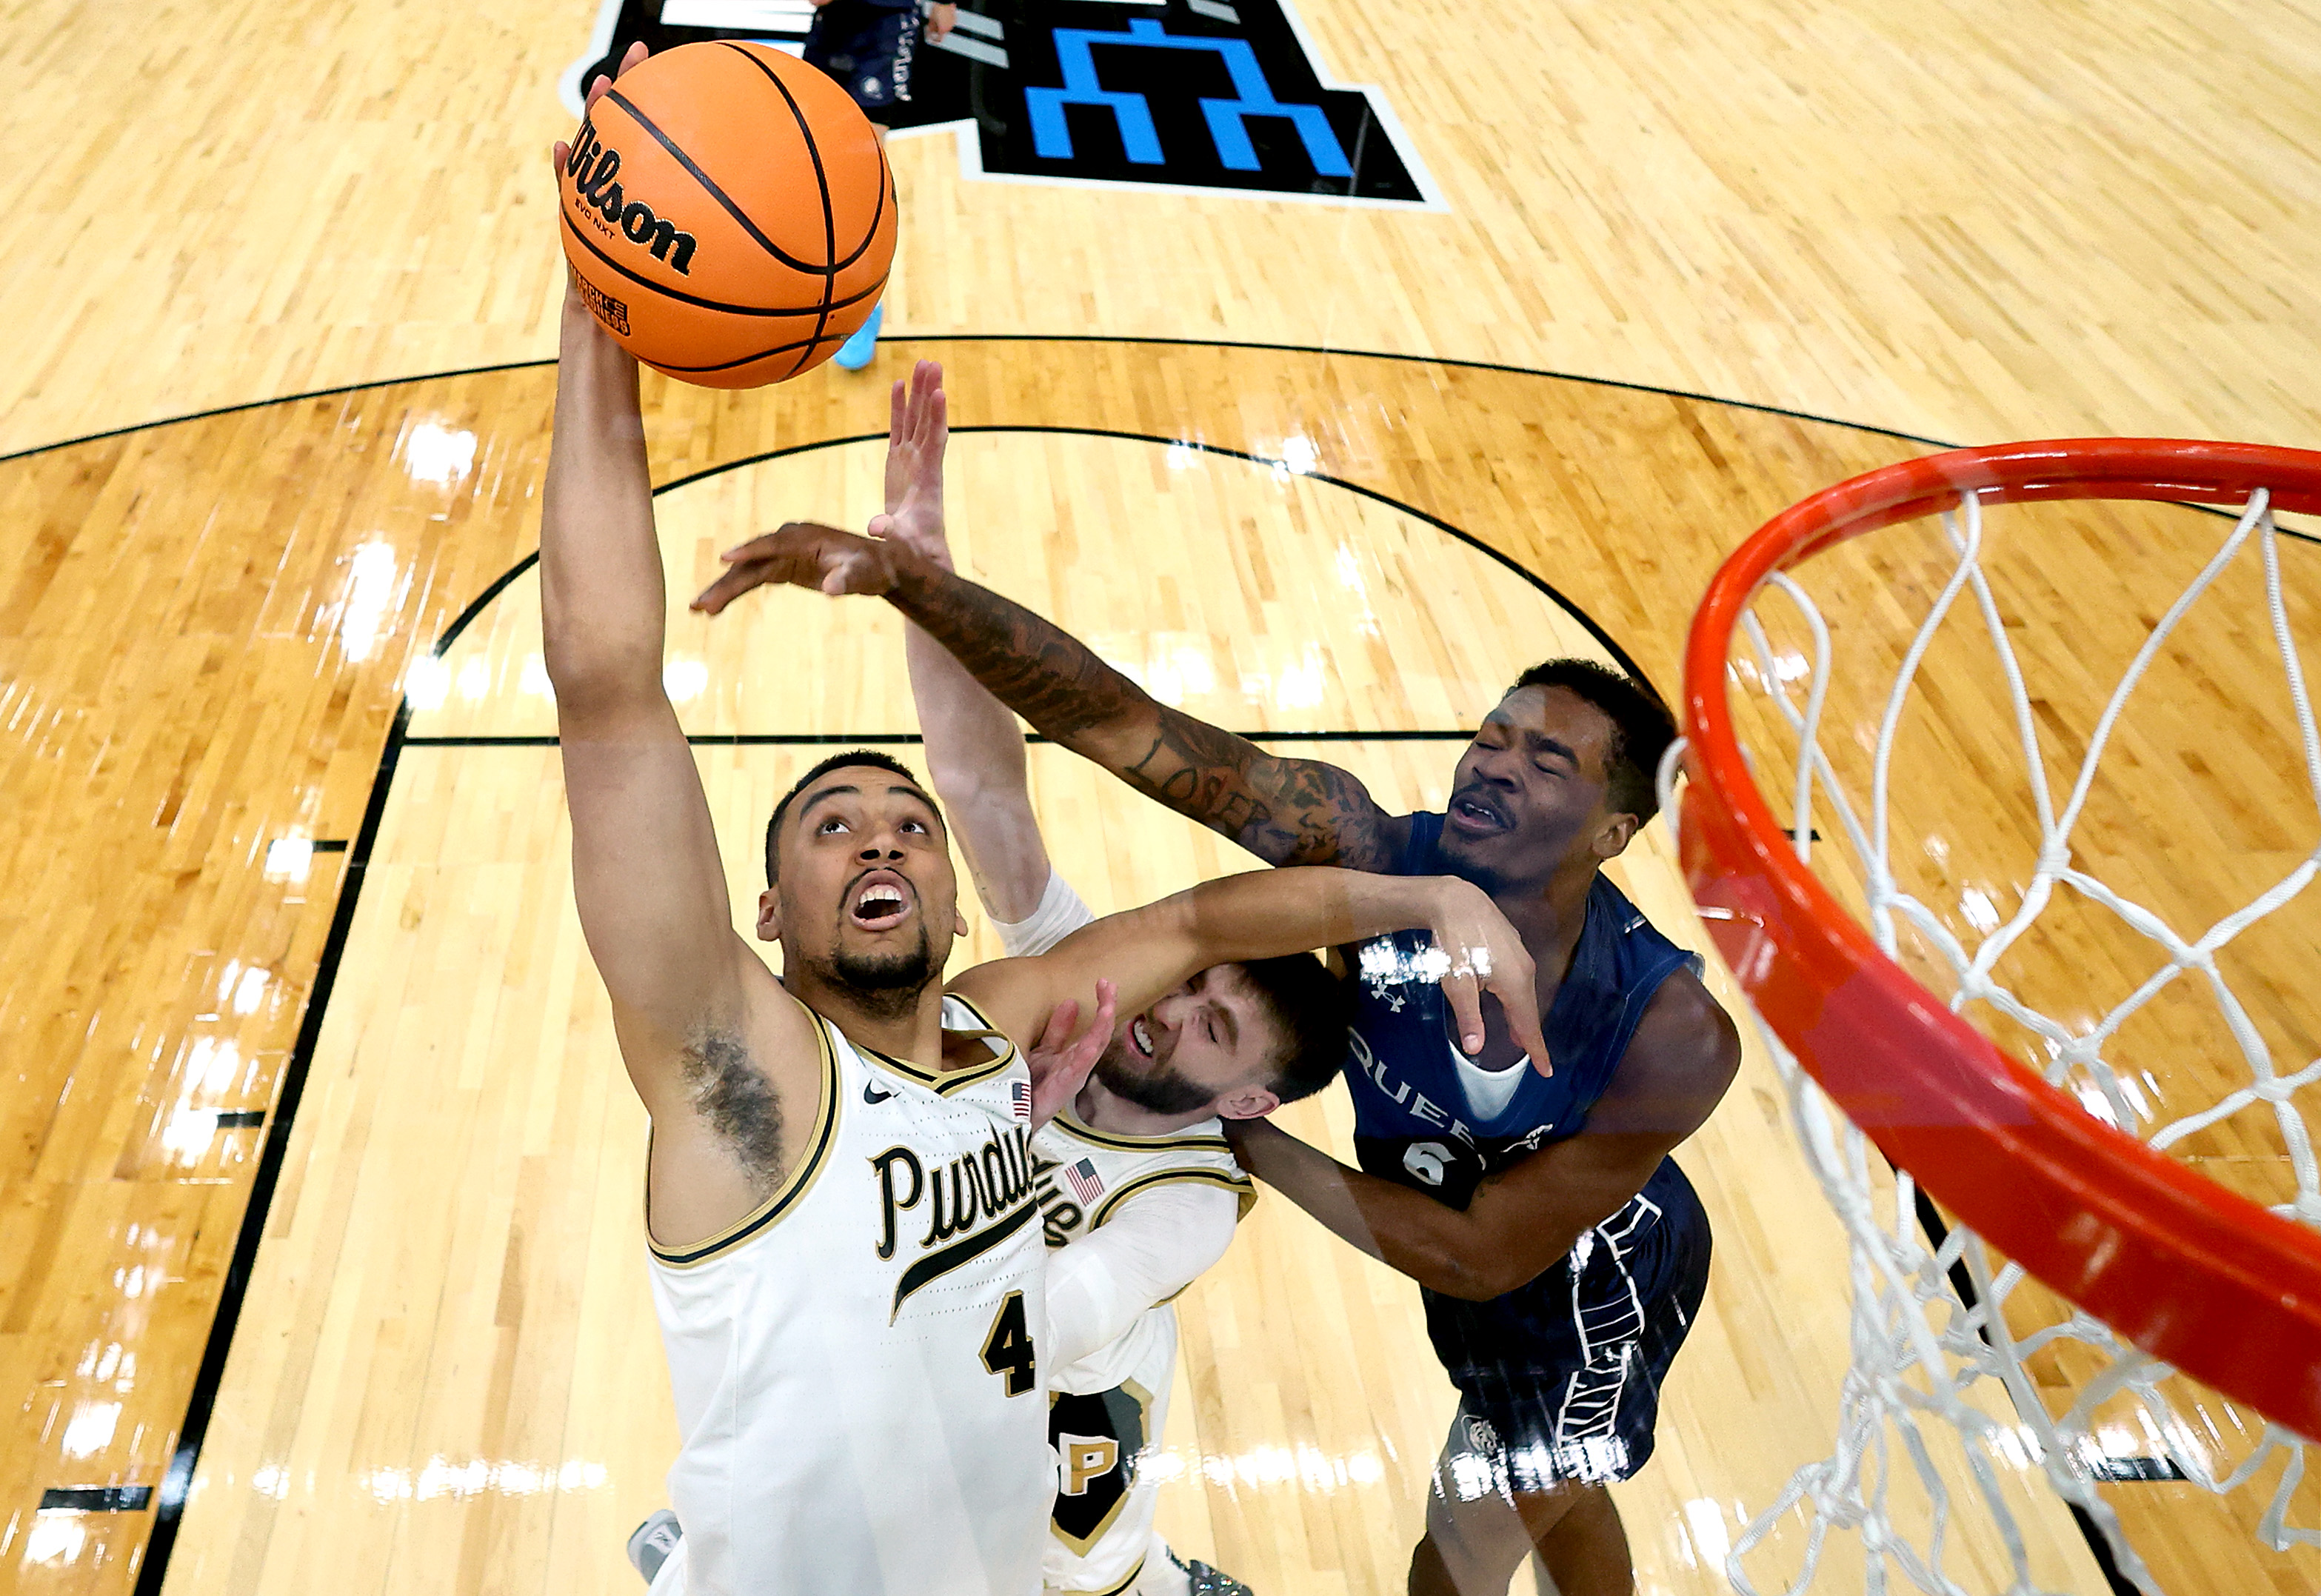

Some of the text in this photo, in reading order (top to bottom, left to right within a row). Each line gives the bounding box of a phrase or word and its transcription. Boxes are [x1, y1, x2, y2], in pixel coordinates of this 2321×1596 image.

[575, 198, 615, 240] EVO NXT
[866, 1115, 1035, 1261] Purdu
[1402, 1141, 1457, 1186] 6
[978, 1289, 1035, 1398] 4
[1058, 1432, 1120, 1496] P
